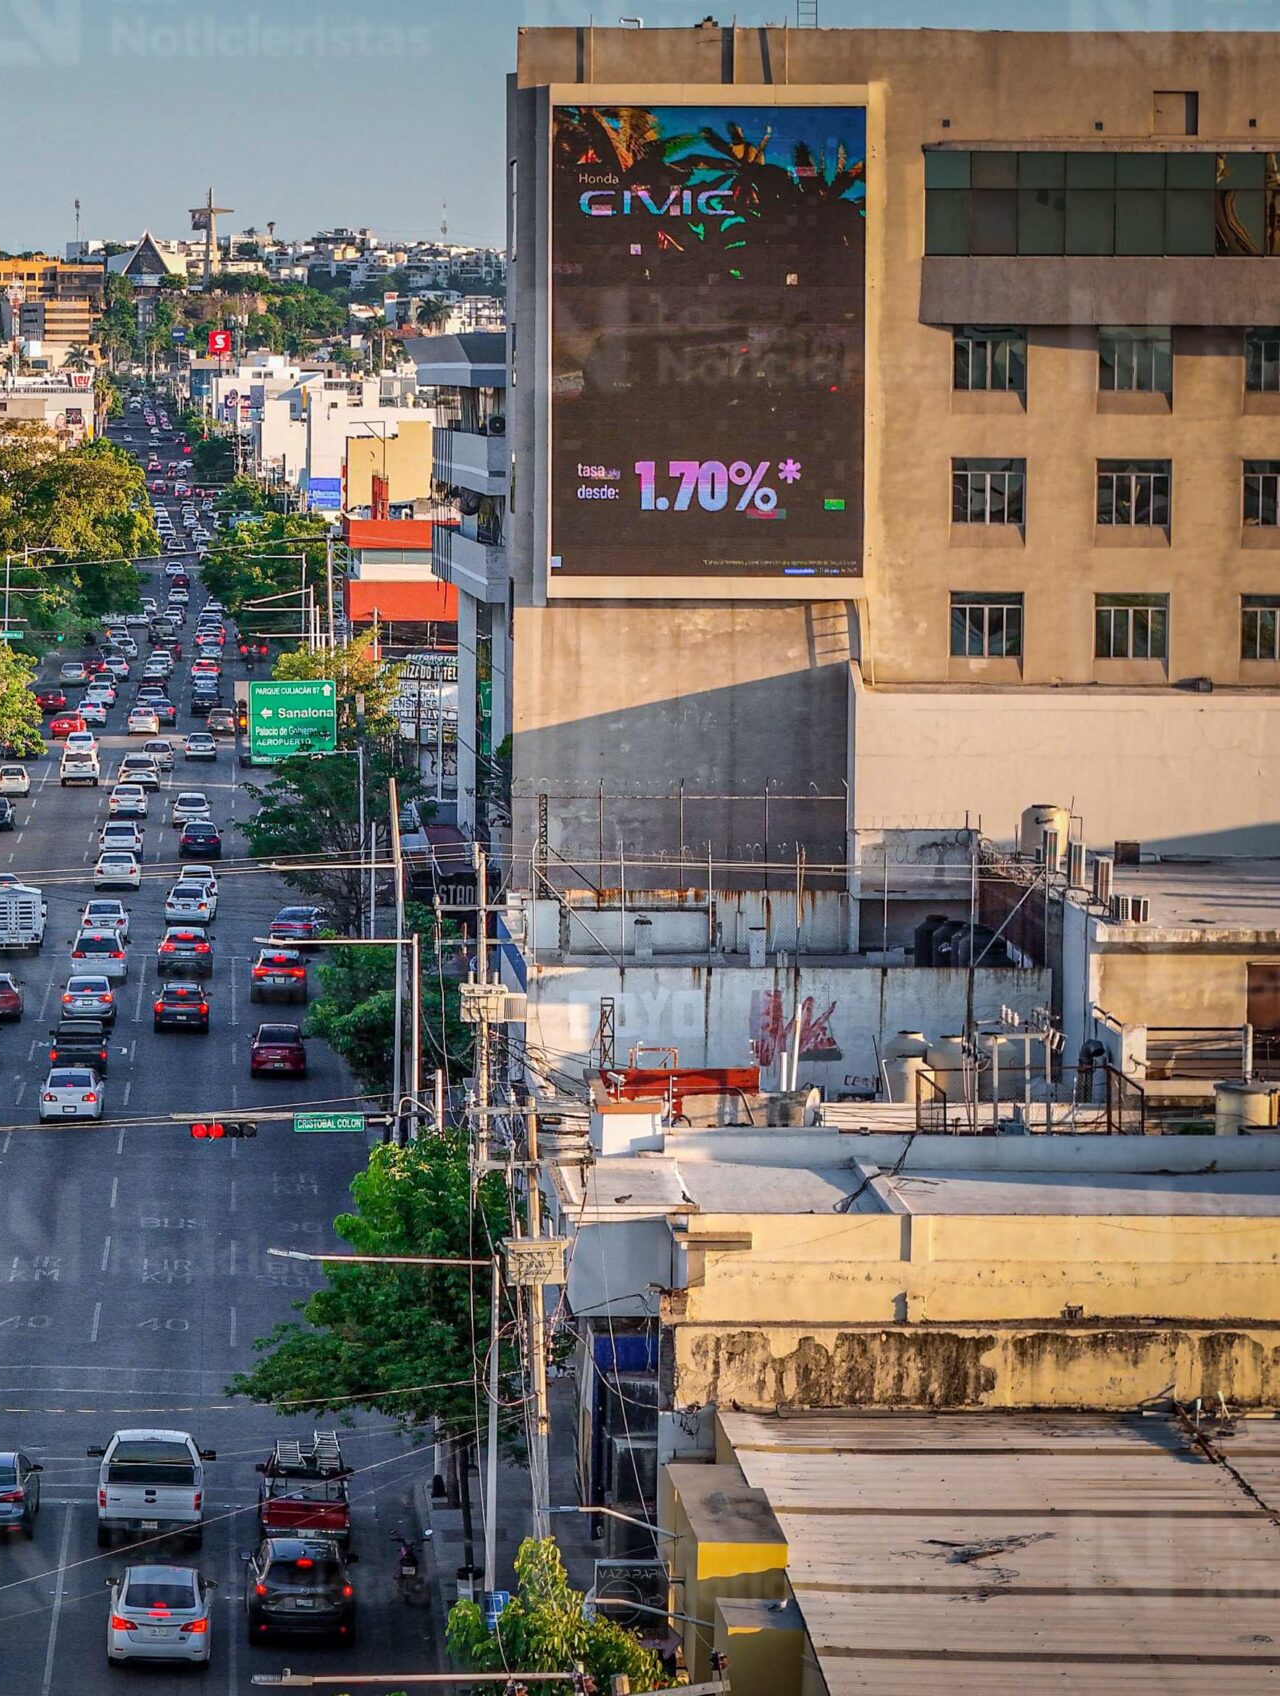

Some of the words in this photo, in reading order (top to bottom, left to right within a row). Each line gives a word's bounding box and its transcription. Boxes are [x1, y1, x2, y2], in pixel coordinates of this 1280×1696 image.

[578, 173, 619, 184] Honda
[579, 189, 735, 216] CIVIC
[577, 462, 605, 477] tasa
[577, 485, 619, 499] desde:
[278, 707, 334, 719] Sanalona
[256, 726, 279, 736] Palacio
[280, 727, 288, 735] de
[297, 1119, 336, 1129] CRISTOBAL
[337, 1119, 361, 1129] COLON
